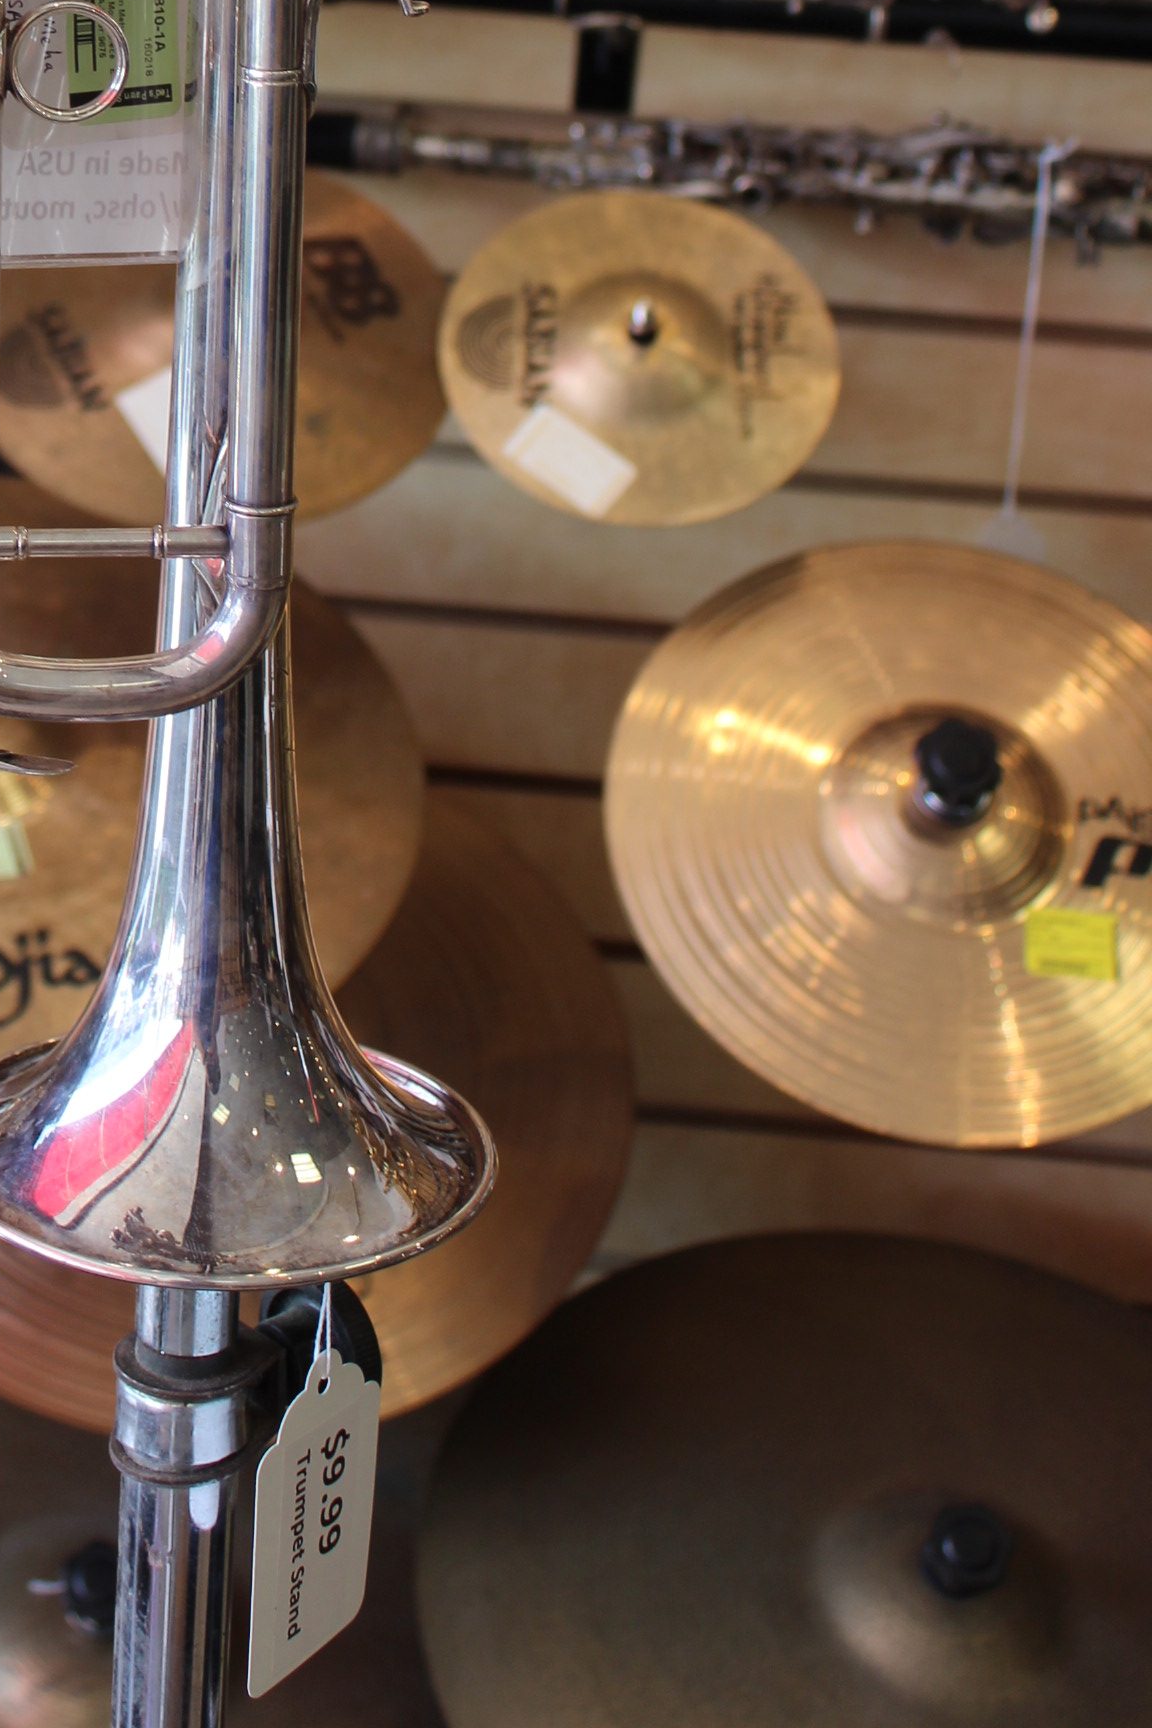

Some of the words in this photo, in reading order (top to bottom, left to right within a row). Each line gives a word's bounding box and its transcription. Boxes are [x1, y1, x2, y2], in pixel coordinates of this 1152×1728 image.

[290, 1447, 311, 1561] Trumpet
[318, 1428, 350, 1556] $9.99
[286, 1566, 305, 1641] Stand
